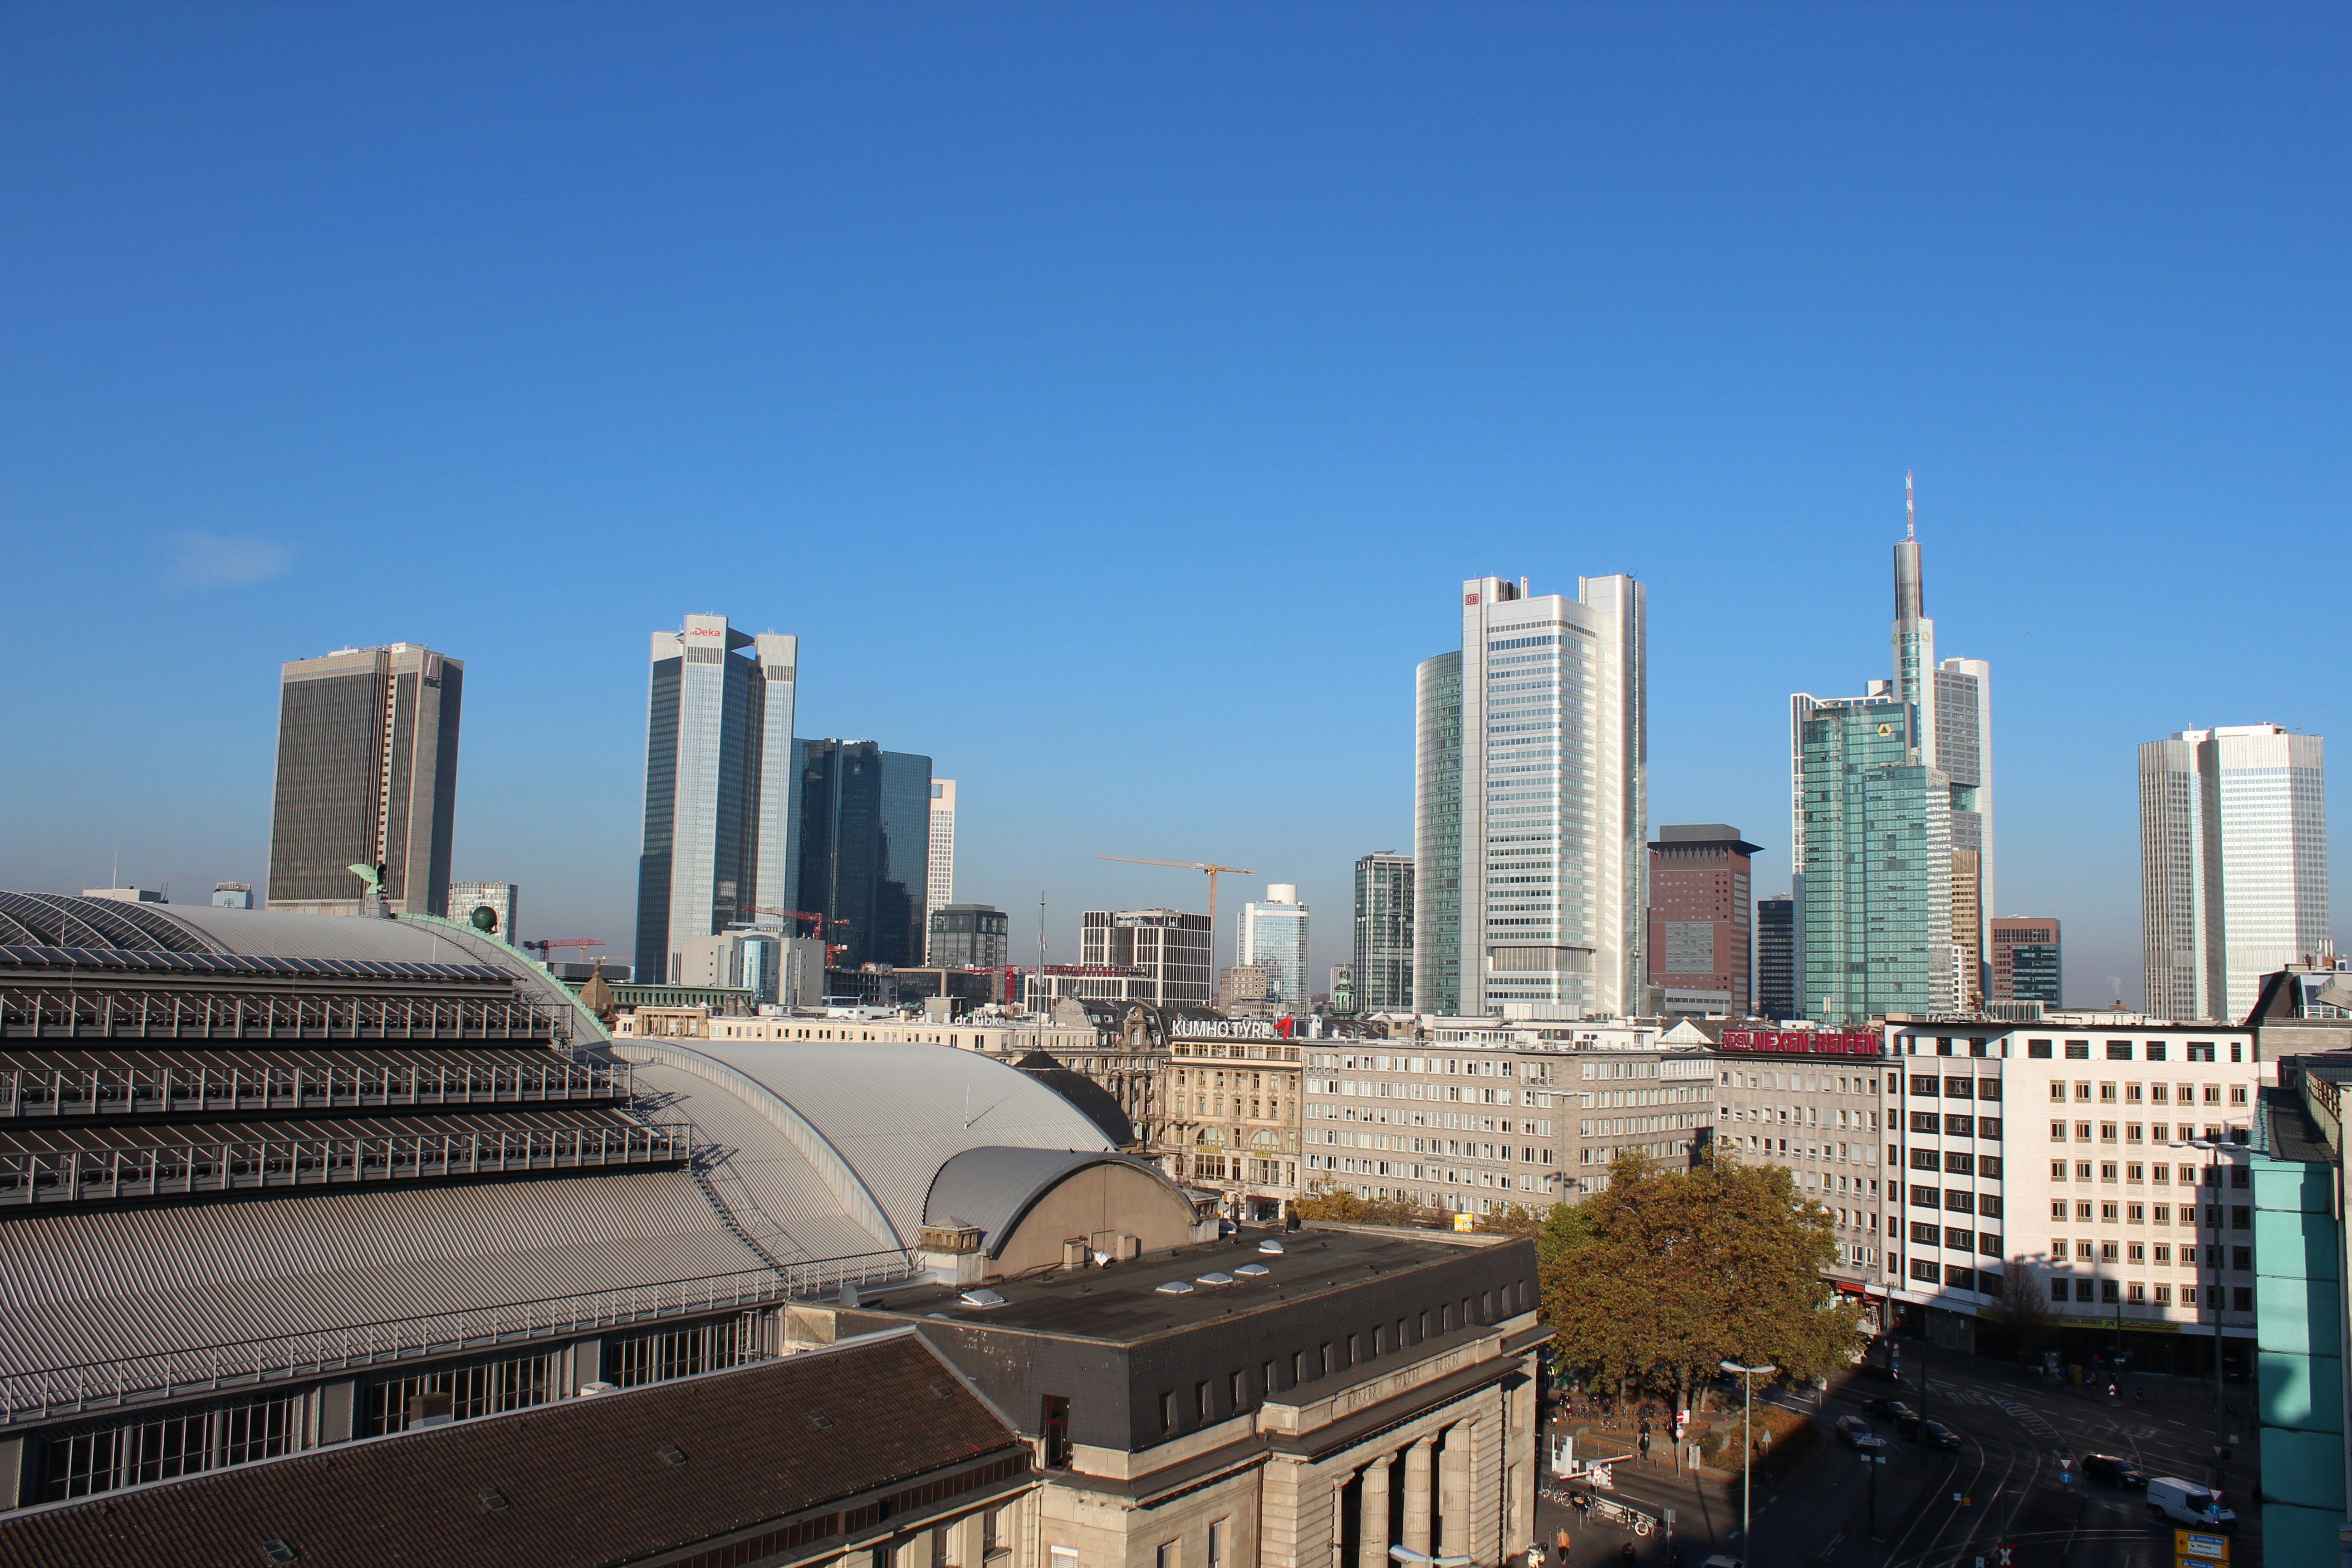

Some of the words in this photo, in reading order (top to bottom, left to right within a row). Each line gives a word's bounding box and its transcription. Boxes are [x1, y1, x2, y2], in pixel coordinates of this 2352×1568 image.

[1467, 595, 1477, 603] DB
[695, 627, 720, 637] Deka
[955, 1014, 968, 1025] dr
[973, 1014, 1006, 1027] lübke
[1172, 1020, 1229, 1038] KUMHO
[1232, 1020, 1270, 1039] TYRE
[1753, 1032, 1810, 1052] NEXEN
[1816, 1034, 1877, 1054] REIFEN
[1447, 1157, 1508, 1169] HEILPRAKTIKERSCHULE
[1946, 1392, 1990, 1405] BUS
[2189, 1548, 2220, 1556] Palmengarten
